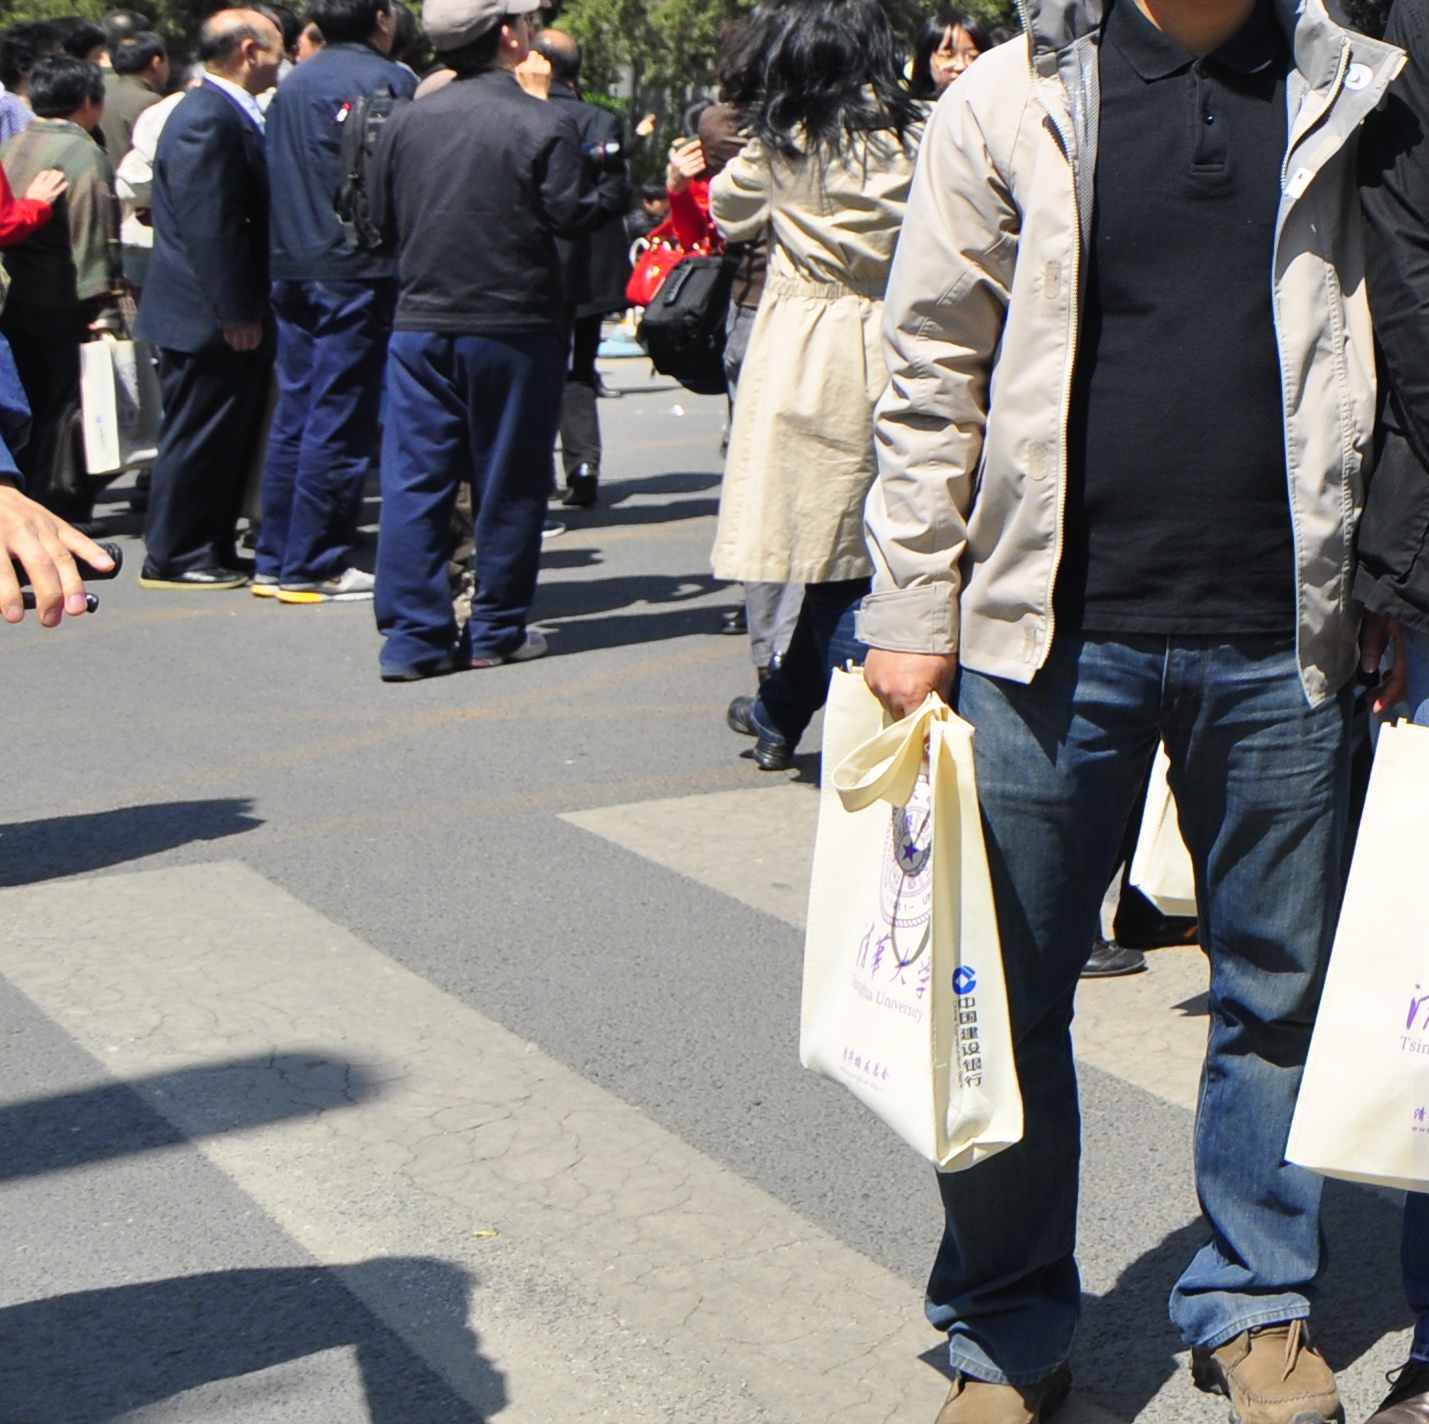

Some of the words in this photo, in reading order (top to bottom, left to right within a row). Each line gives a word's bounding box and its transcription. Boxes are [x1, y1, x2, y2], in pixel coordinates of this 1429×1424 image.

[876, 991, 925, 1024] University
[958, 996, 984, 1088] 中国建设银行
